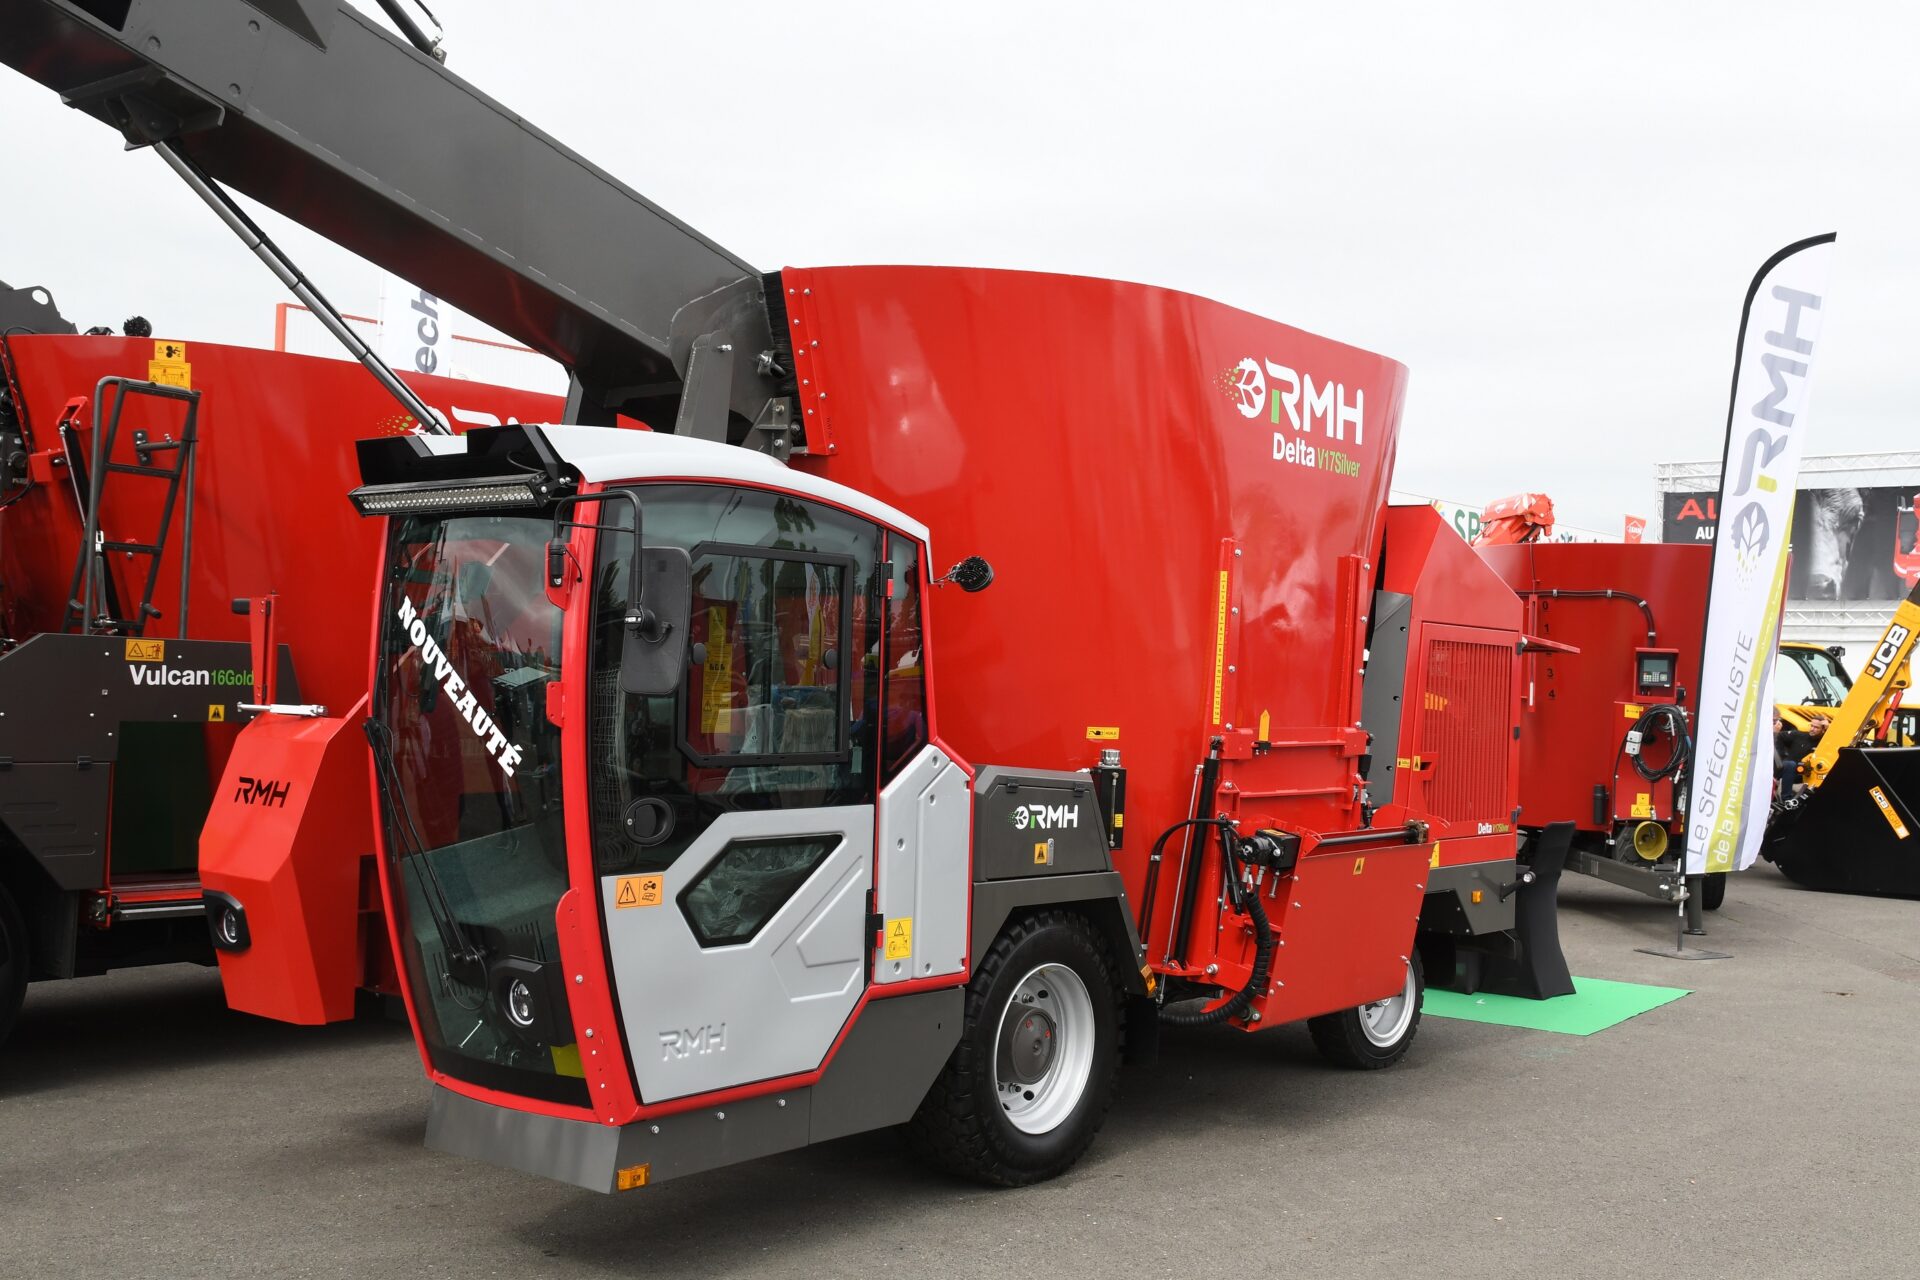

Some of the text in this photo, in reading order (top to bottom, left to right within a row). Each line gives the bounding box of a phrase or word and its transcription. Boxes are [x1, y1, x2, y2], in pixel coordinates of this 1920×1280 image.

[411, 289, 439, 374] ech
[1265, 356, 1364, 445] RMH
[1732, 285, 1822, 497] RMH
[1273, 432, 1361, 478] Delta V17Silver
[1871, 625, 1908, 679] JCB
[129, 664, 254, 686] Vulcan 16Gold
[398, 595, 524, 778] NOUVEAUTÉ
[1687, 631, 1753, 856] Le SPÉCIALISTE
[234, 776, 291, 808] RMH
[1873, 790, 1889, 809] JCB
[1029, 804, 1079, 829] RMH
[1718, 821, 1734, 837] la
[1713, 839, 1730, 864] de
[659, 1022, 726, 1061] RMH
